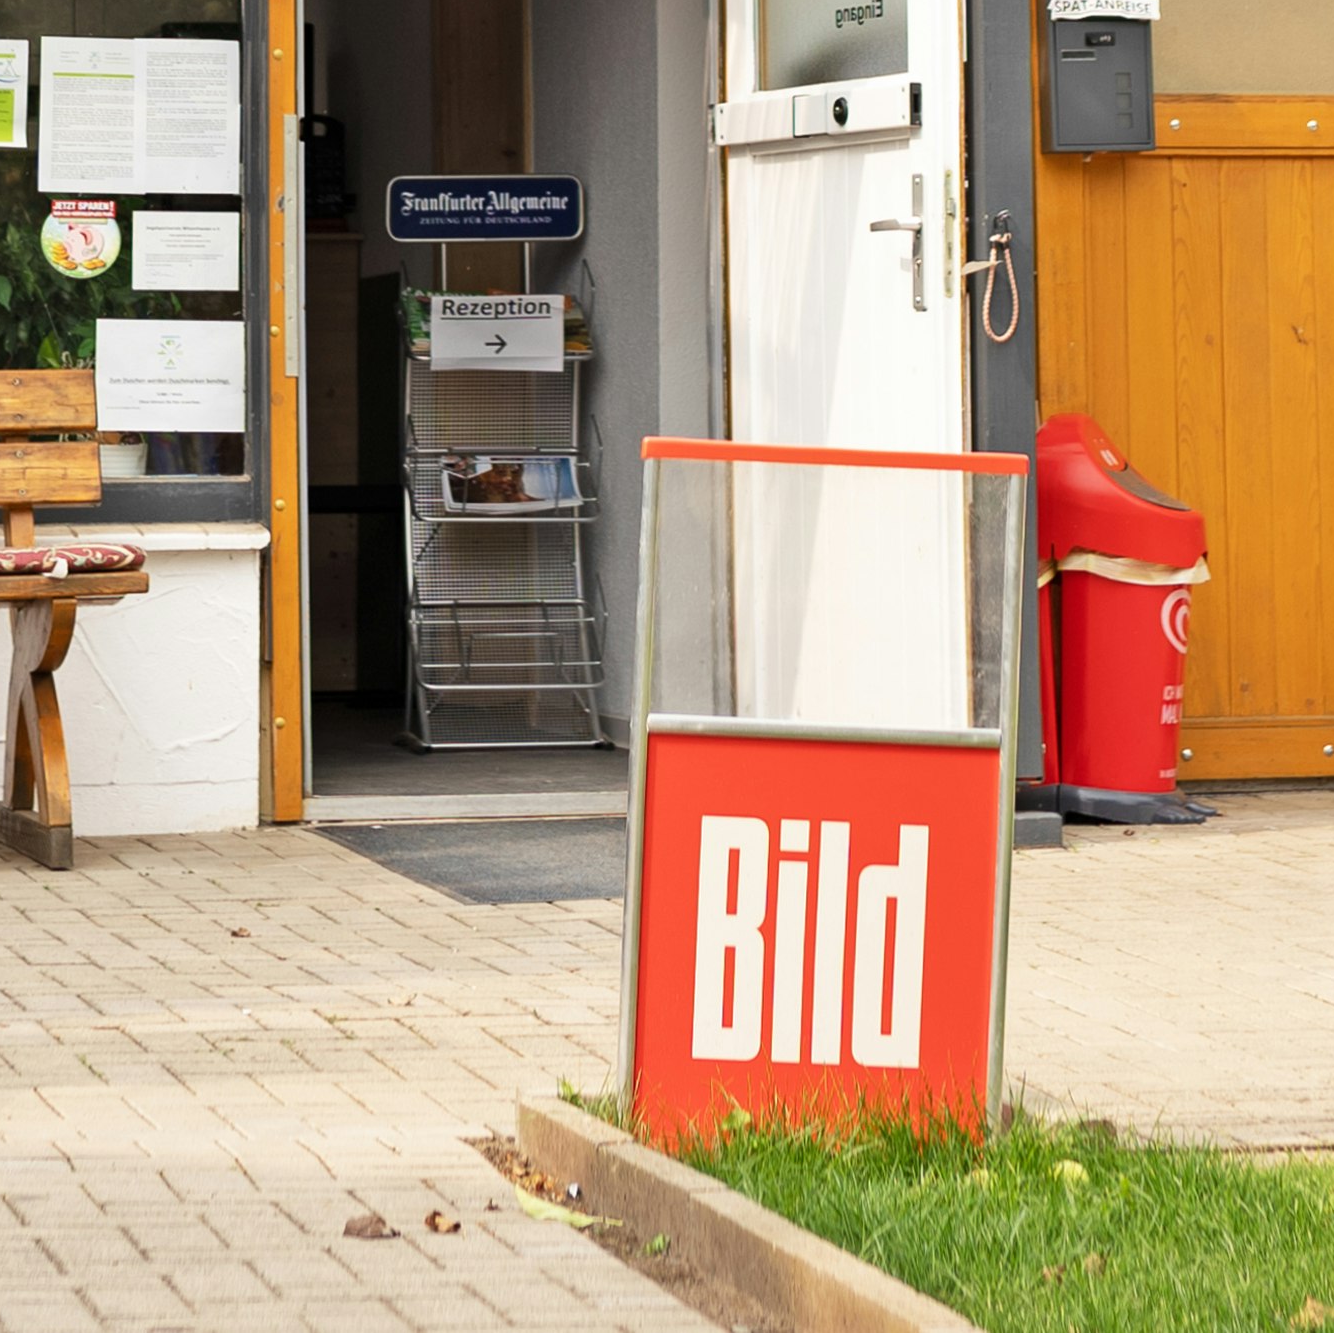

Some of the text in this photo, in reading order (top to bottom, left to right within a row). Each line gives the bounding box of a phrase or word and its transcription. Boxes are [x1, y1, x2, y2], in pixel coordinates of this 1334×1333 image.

[486, 191, 569, 215] Allgemeine
[419, 216, 552, 225] ZEITUNG FÜR DEUTSCHLAND
[442, 298, 551, 319] Rezeption
[692, 815, 929, 1069] Bild
